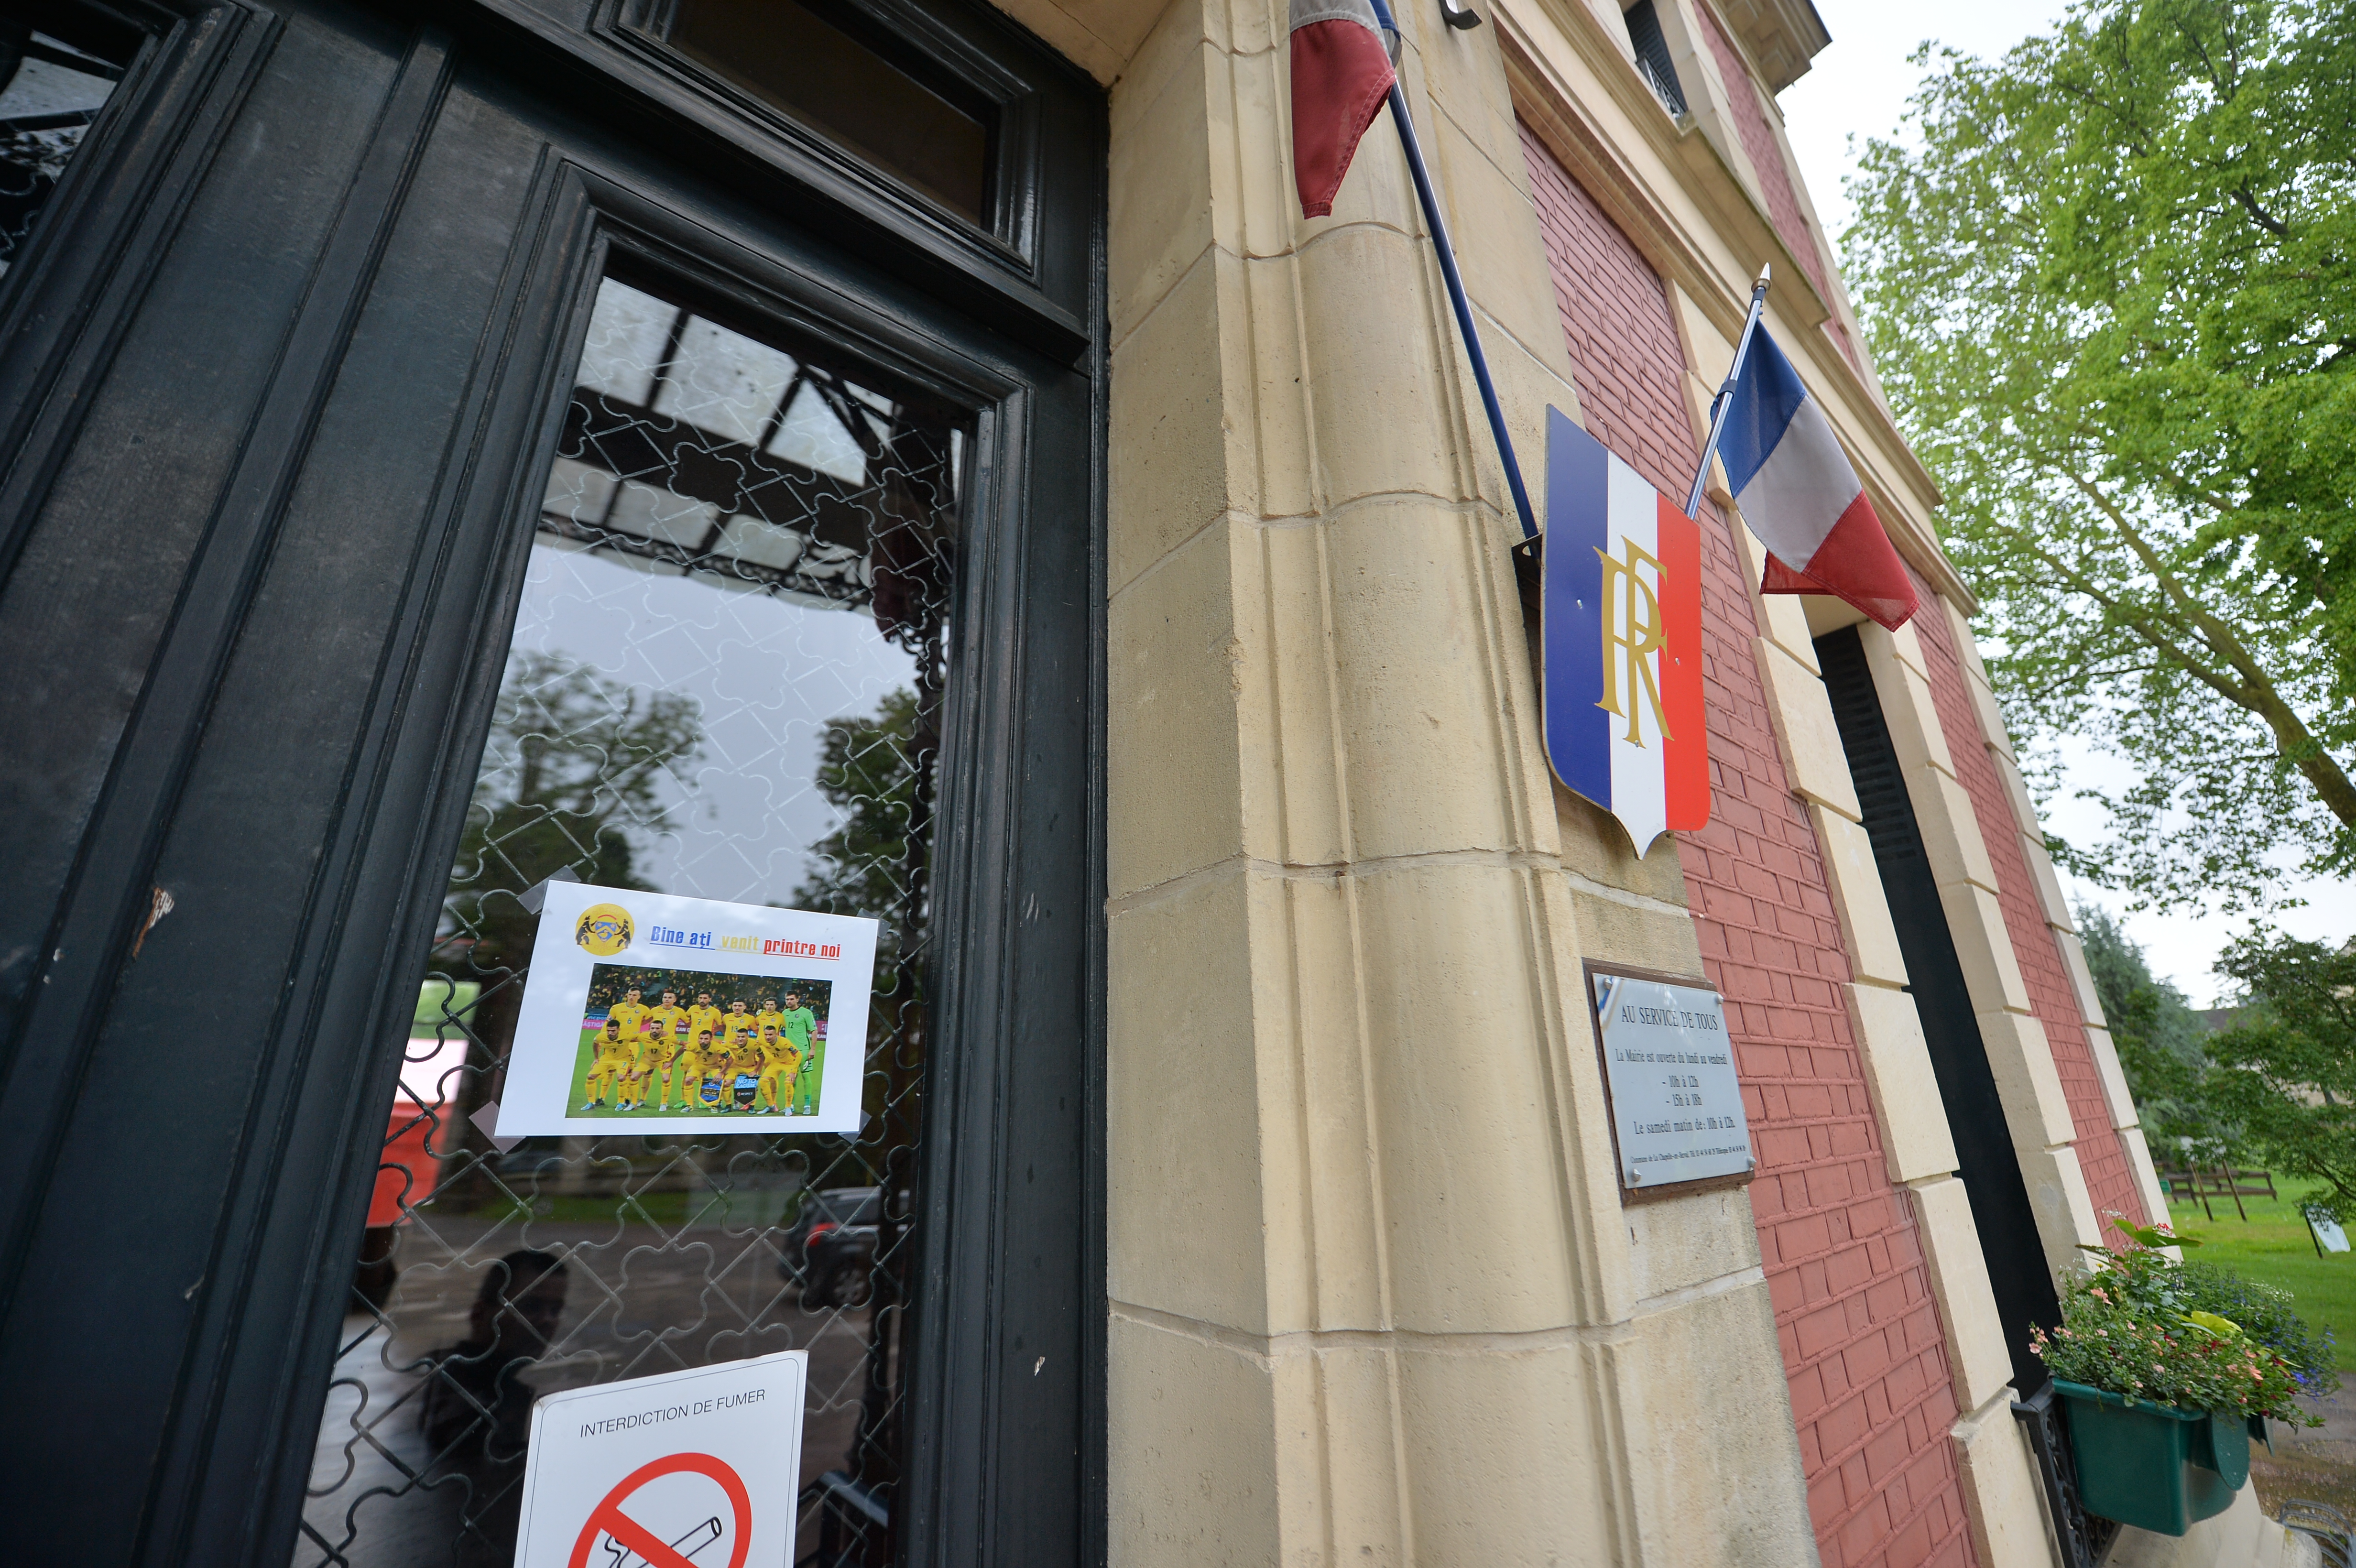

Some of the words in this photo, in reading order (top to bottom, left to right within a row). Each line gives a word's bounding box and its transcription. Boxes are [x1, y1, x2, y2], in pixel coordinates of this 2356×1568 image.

[651, 926, 684, 943] Bine
[689, 932, 711, 949] ați
[721, 935, 759, 950] venit
[763, 939, 816, 955] printre
[821, 944, 840, 958] noi
[1622, 1005, 1636, 1023] AU
[1640, 1007, 1679, 1027] SERVICE
[1680, 1011, 1694, 1028] DE
[1695, 1013, 1718, 1030] TOUS
[1615, 1048, 1624, 1061] La
[1625, 1049, 1645, 1062] Mairie
[1647, 1052, 1655, 1062] est
[1657, 1053, 1676, 1063] ouverte
[1678, 1052, 1685, 1063] du
[1685, 1052, 1699, 1064] lundi
[1701, 1056, 1707, 1064] au
[1707, 1054, 1728, 1065] vendredi
[1669, 1075, 1680, 1087] 10h
[1682, 1075, 1687, 1087] à
[1688, 1075, 1699, 1087] 12h
[1685, 1093, 1690, 1106] à
[1633, 1121, 1644, 1134] Le
[1646, 1119, 1671, 1133] samedi
[1674, 1118, 1693, 1132] matin
[1718, 1116, 1723, 1128] à
[580, 1405, 688, 1437] INTERDICTION
[694, 1400, 712, 1415] DE
[717, 1389, 765, 1410] FUMER
